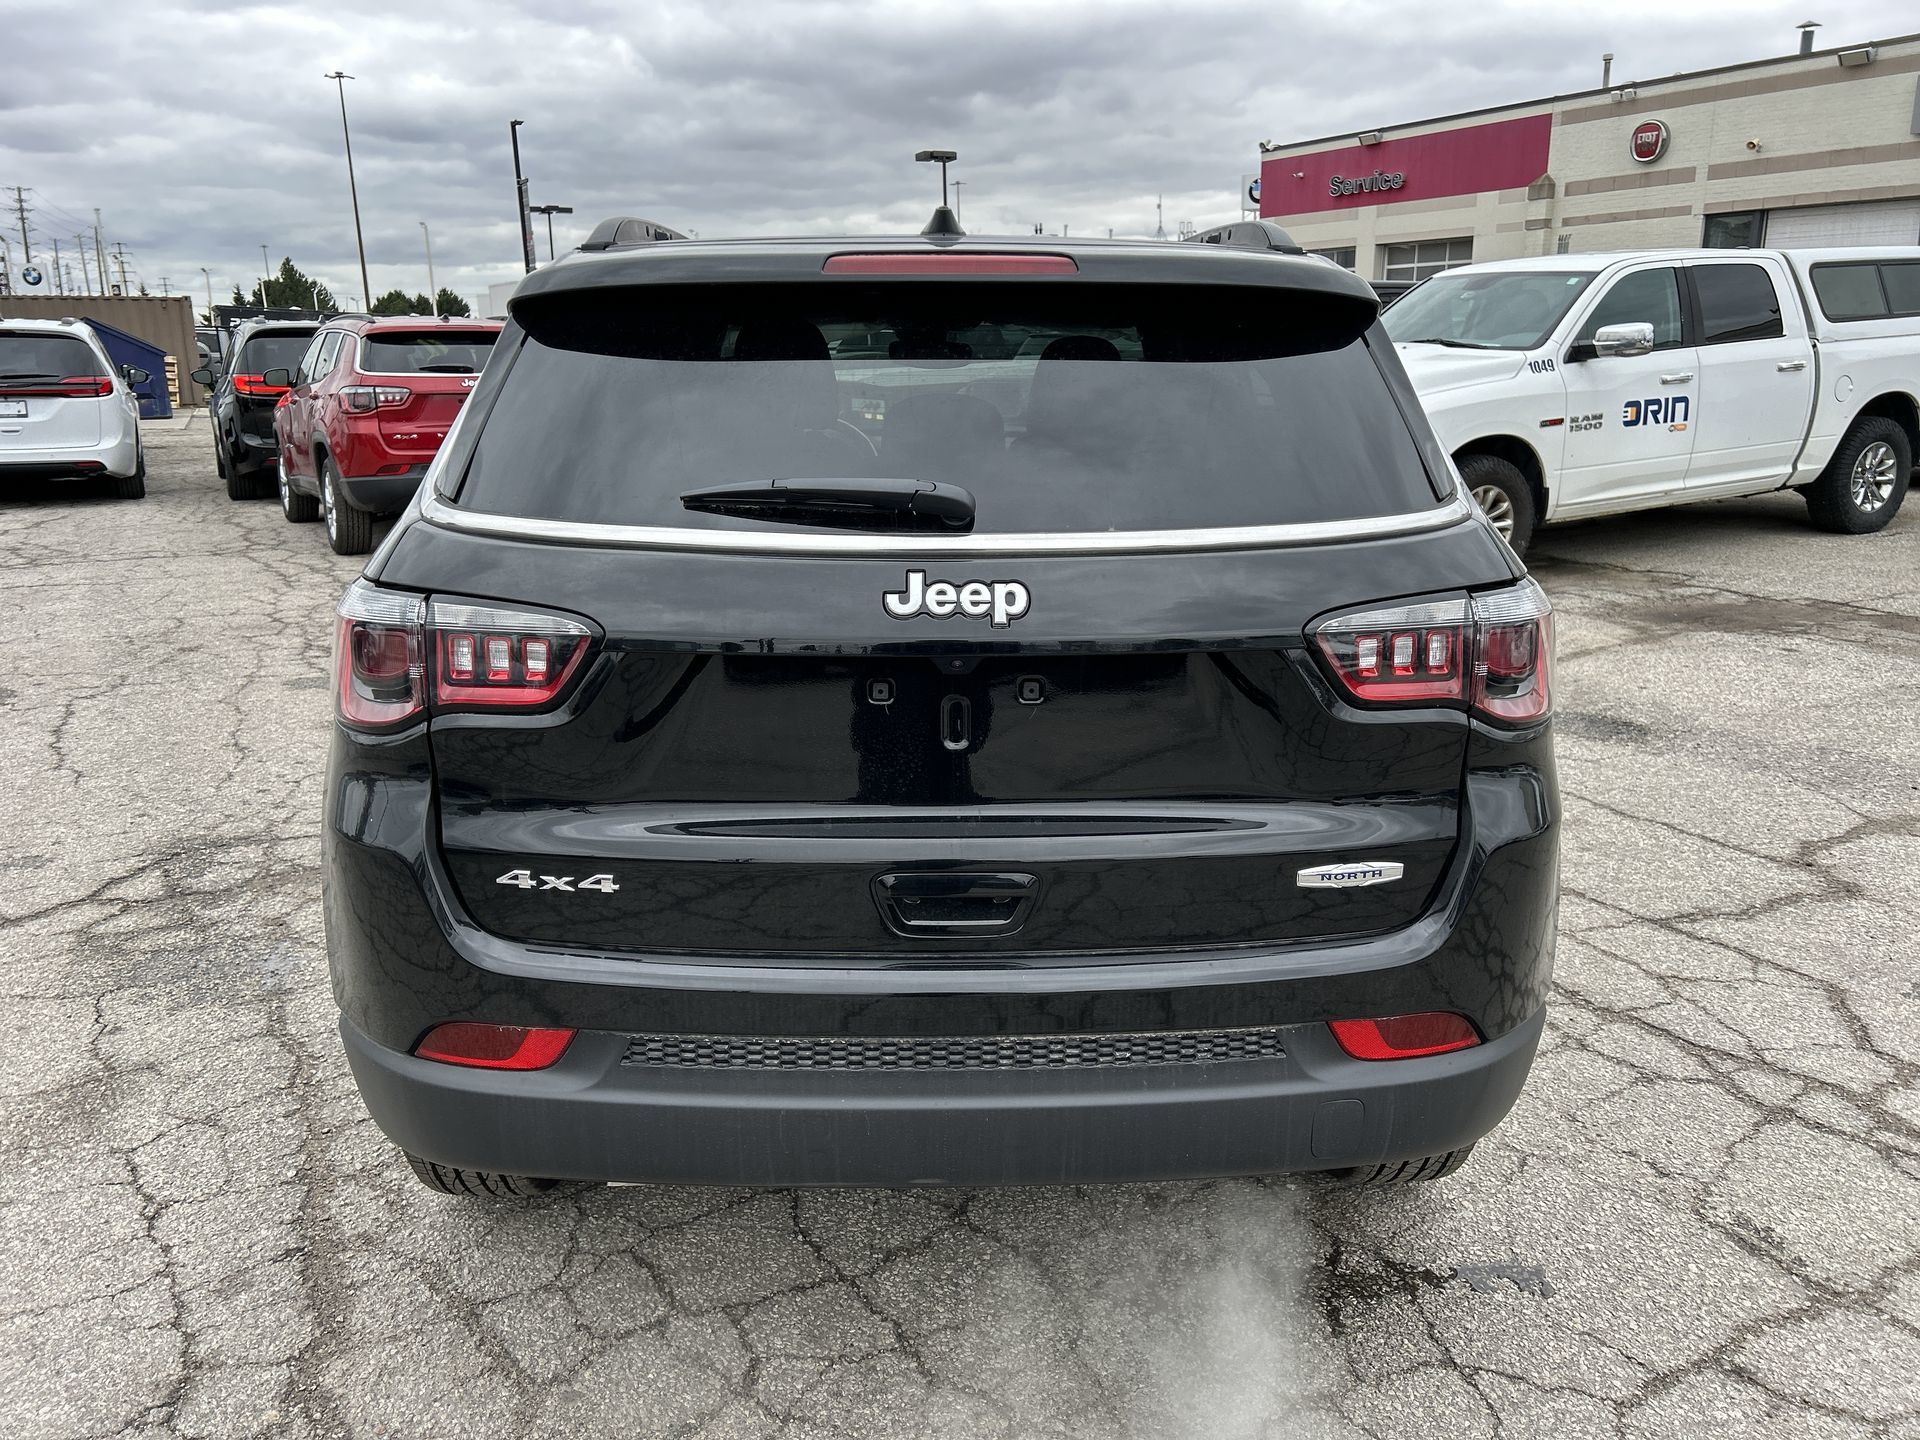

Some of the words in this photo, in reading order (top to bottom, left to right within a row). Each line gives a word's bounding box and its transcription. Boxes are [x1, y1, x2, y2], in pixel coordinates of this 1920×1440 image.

[1637, 131, 1659, 144] FIAT
[1328, 169, 1405, 197] Service
[1527, 358, 1556, 374] 1049
[1569, 412, 1604, 424] RAM
[1569, 421, 1603, 433] 1500
[884, 570, 1031, 627] Jeep
[495, 868, 620, 893] 4x4
[1320, 869, 1383, 881] NORTH
